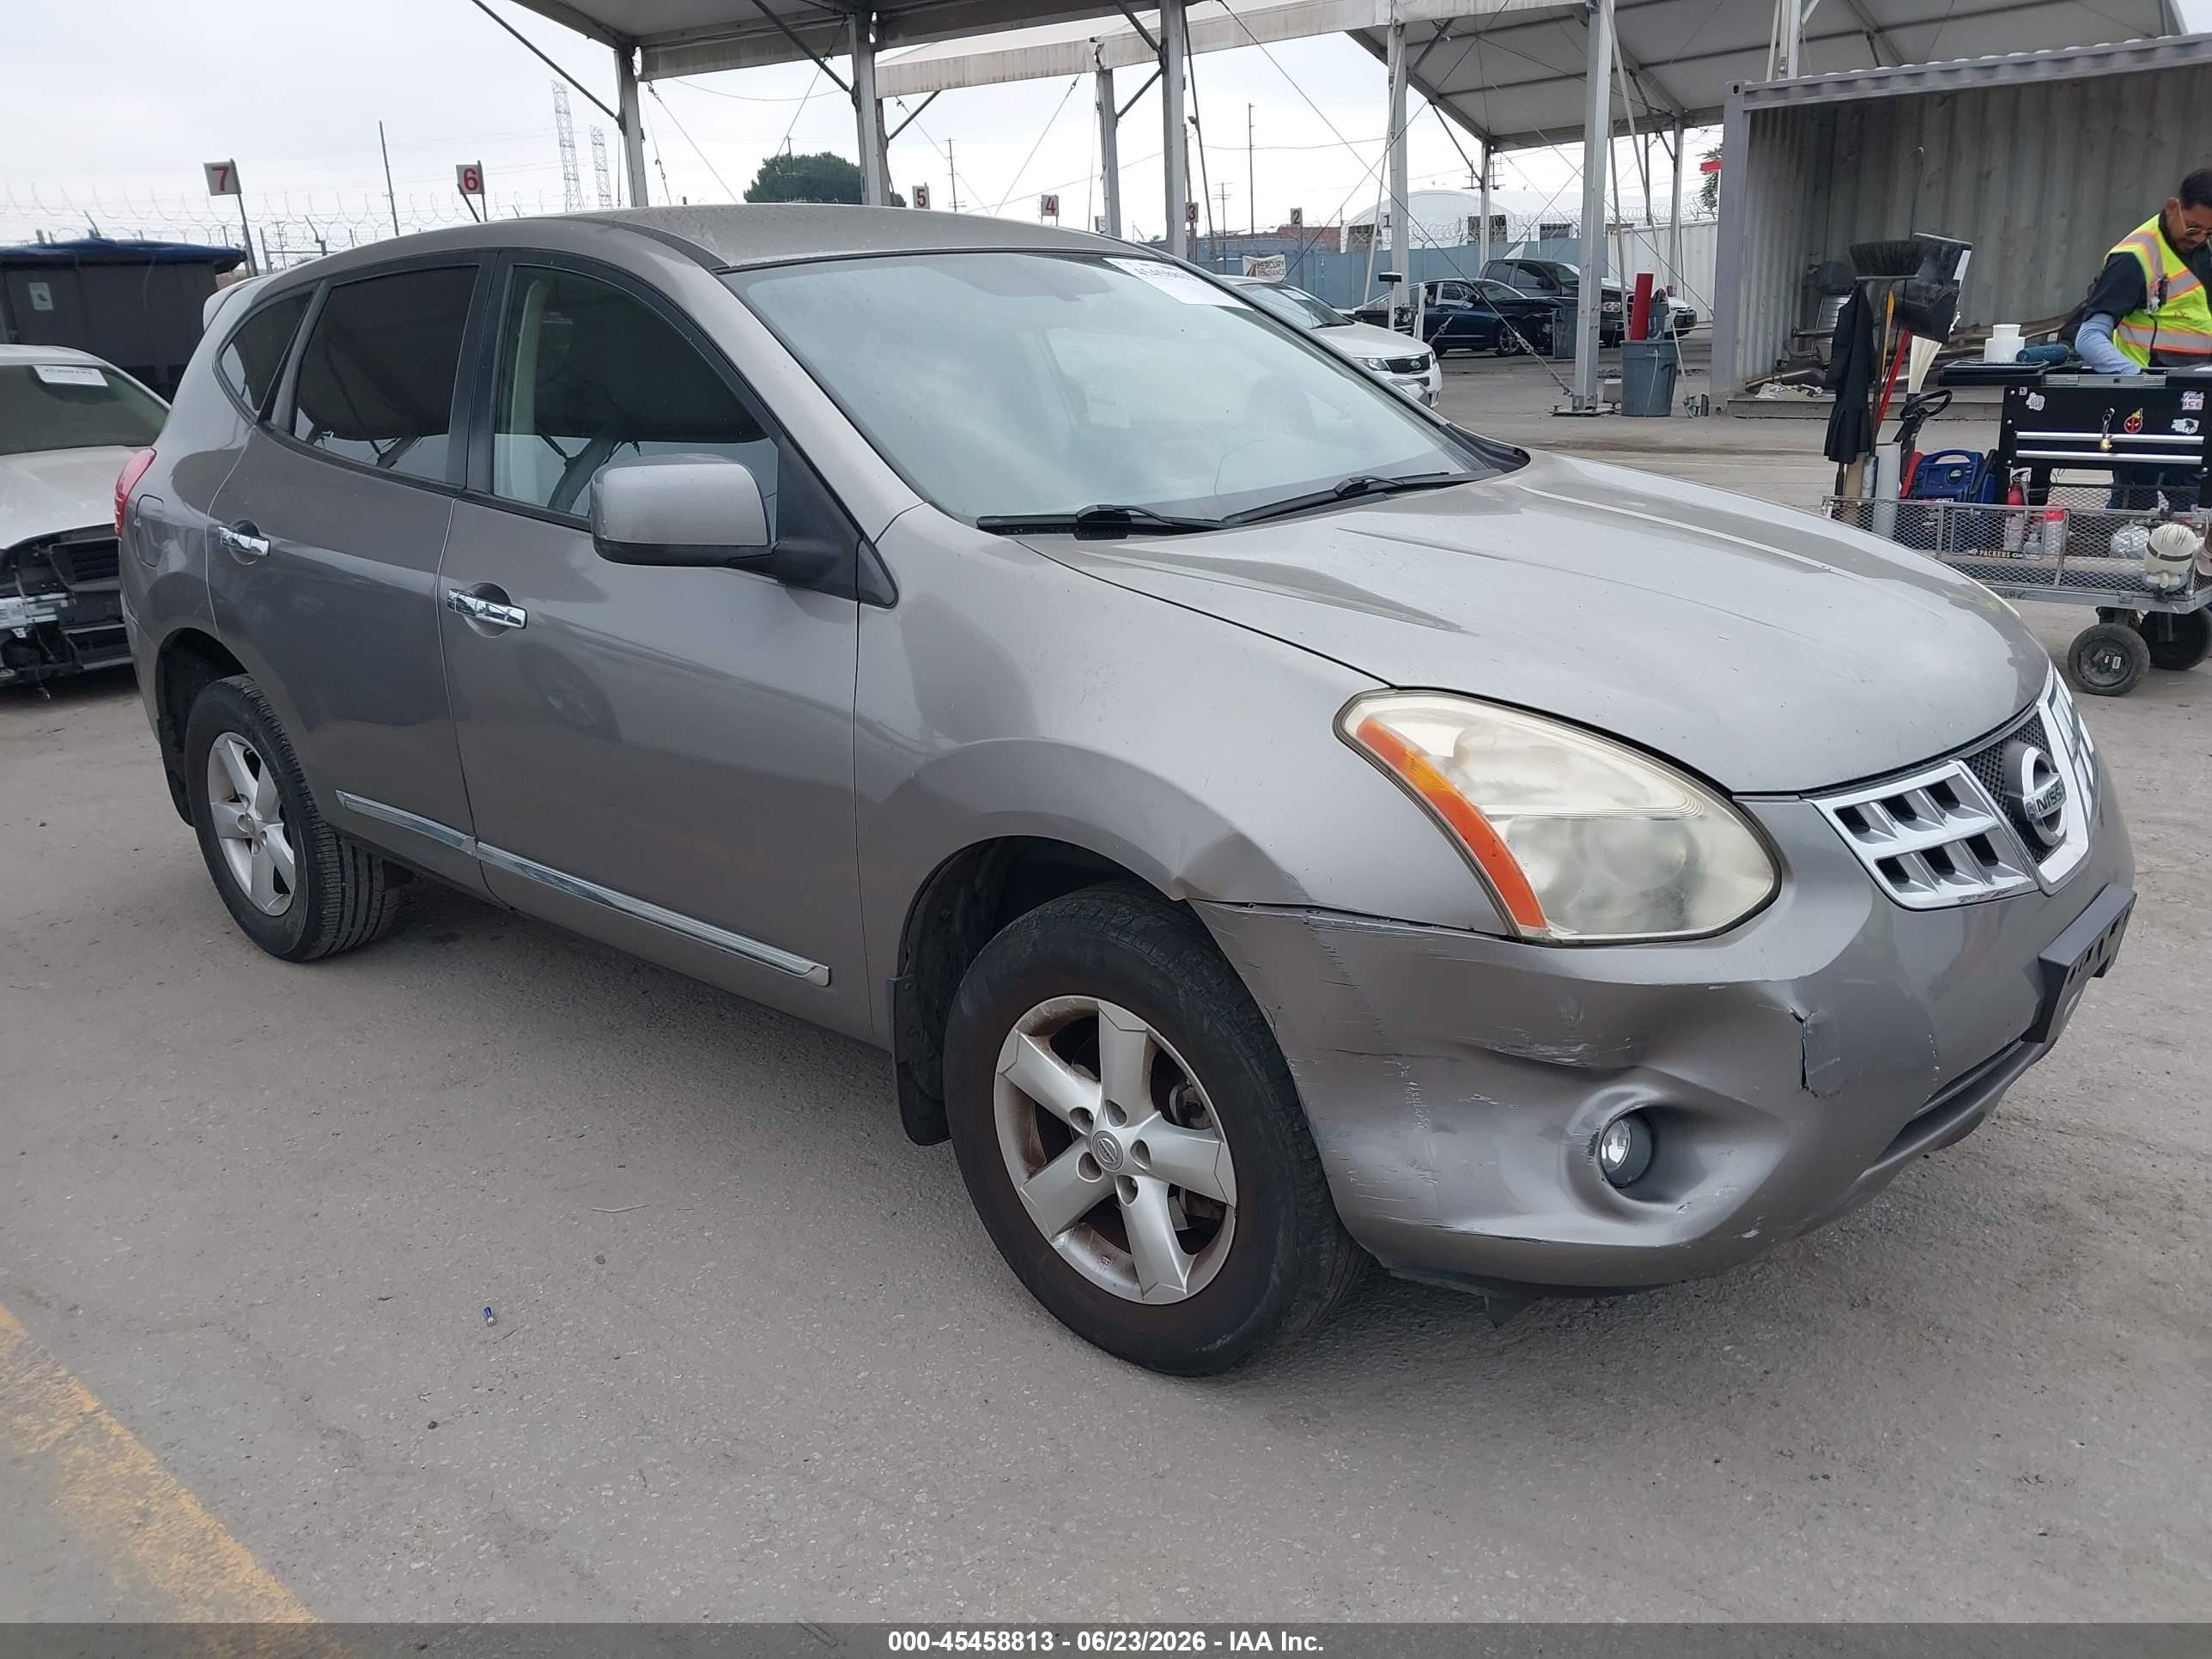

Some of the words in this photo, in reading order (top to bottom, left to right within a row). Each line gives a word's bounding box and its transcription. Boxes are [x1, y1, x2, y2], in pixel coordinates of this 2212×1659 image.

[211, 166, 229, 191] 7
[464, 167, 478, 191] 6
[916, 188, 927, 207] 5
[1045, 197, 1056, 214] 4
[1188, 204, 1195, 221] 3
[1293, 210, 1301, 225] 2
[1382, 214, 1392, 228] 1
[1979, 550, 2010, 558] PACKERS
[2035, 786, 2063, 813] NISS
